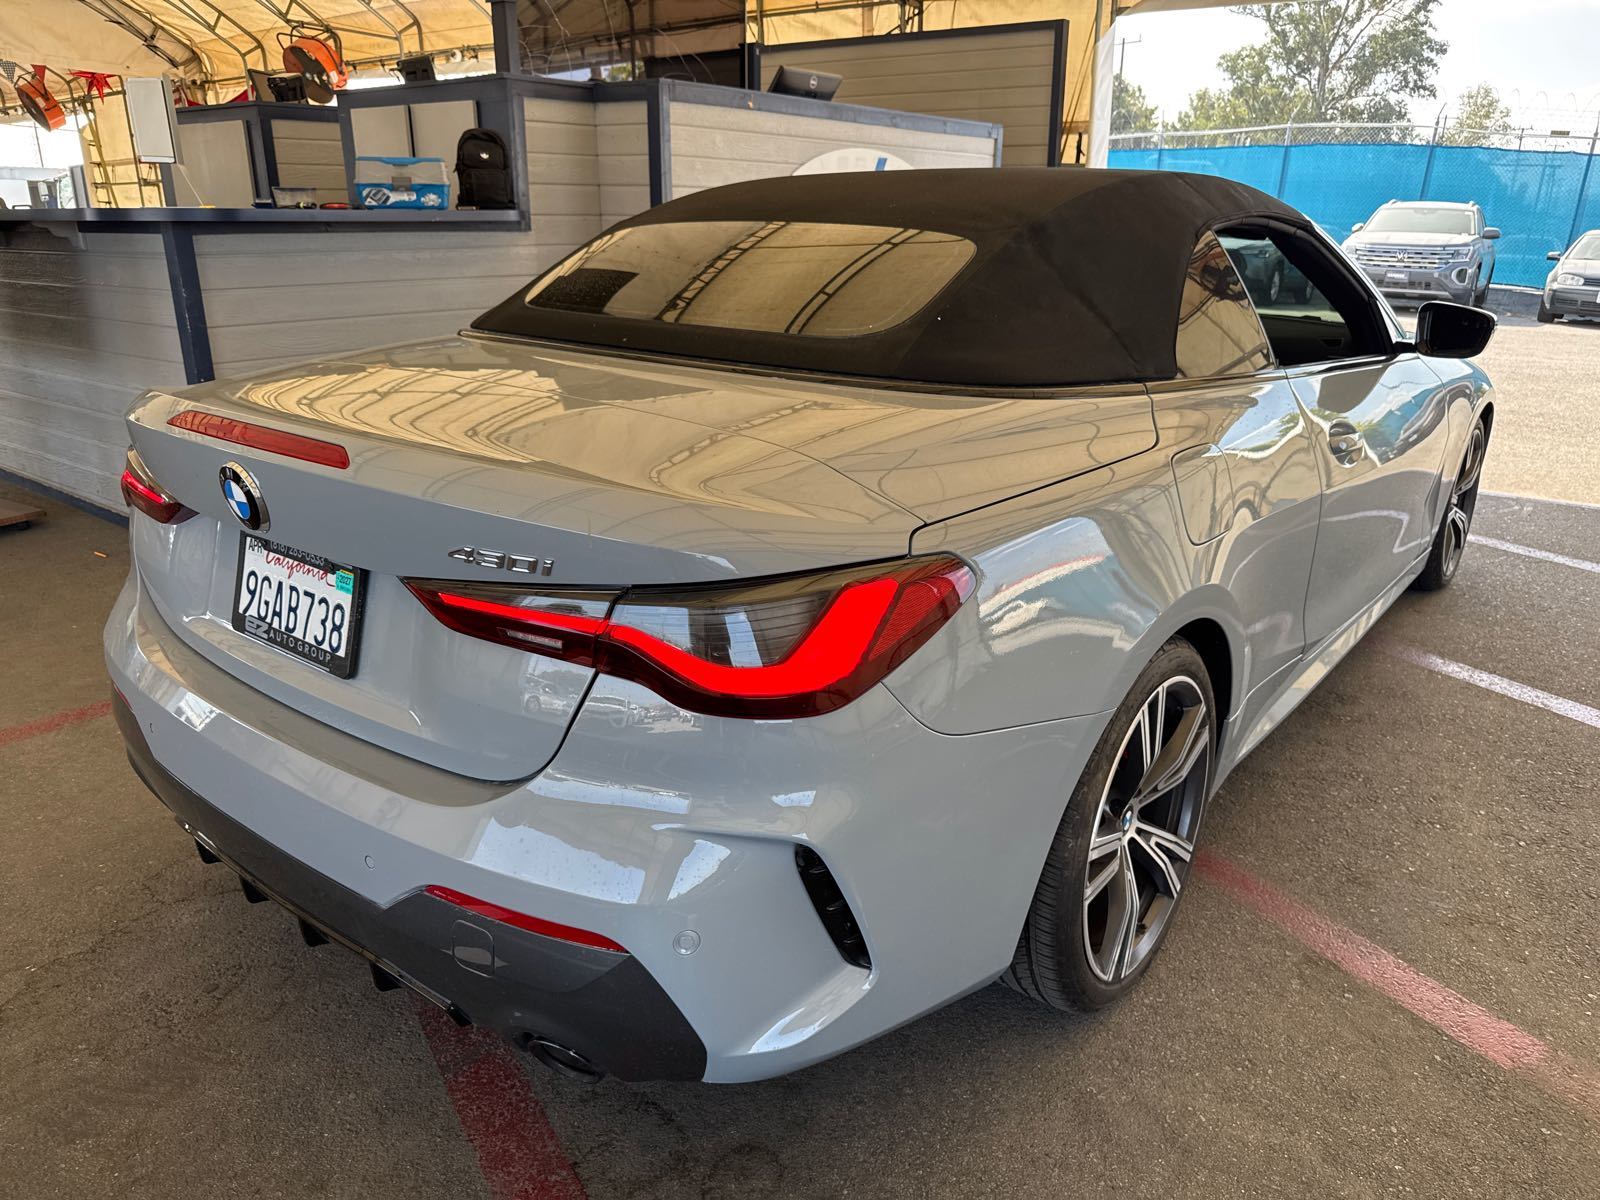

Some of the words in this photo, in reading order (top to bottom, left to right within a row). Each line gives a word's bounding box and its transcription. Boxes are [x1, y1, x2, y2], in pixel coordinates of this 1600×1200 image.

[447, 546, 555, 576] 430i
[243, 570, 346, 653] 9GAB738
[269, 629, 295, 647] AUTO
[297, 640, 331, 663] GROUP
